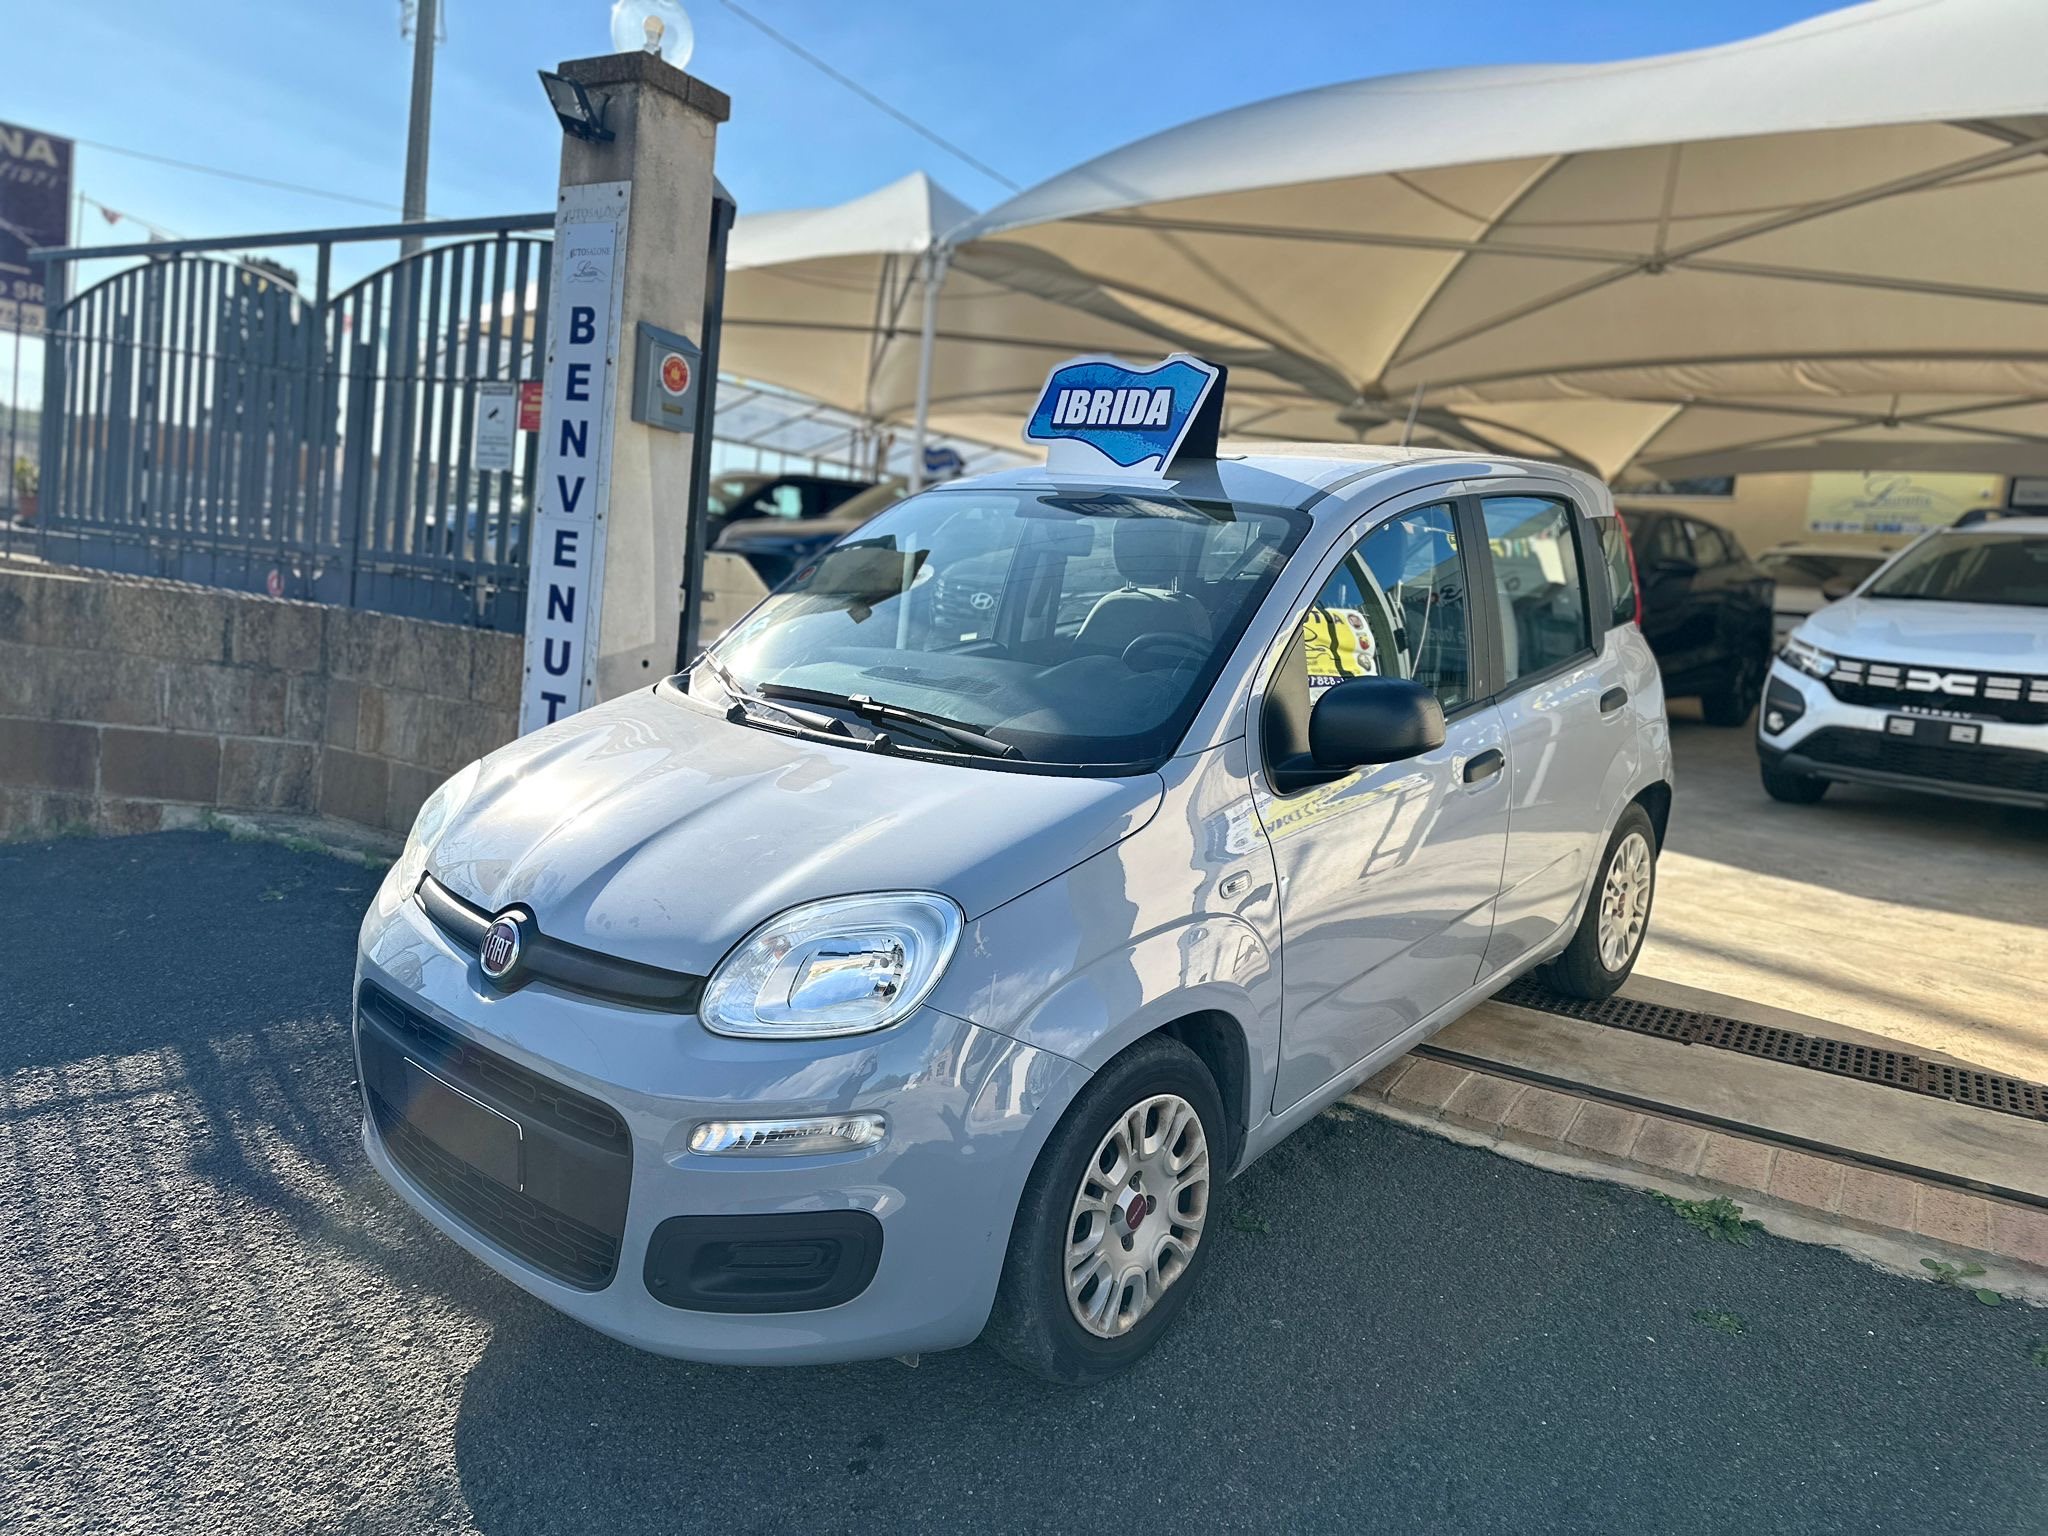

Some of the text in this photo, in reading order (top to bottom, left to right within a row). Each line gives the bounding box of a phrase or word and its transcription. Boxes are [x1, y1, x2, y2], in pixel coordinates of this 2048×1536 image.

[1052, 389, 1172, 426] IBRIDA
[540, 306, 596, 725] BENVENUT
[486, 933, 513, 965] FIAT
